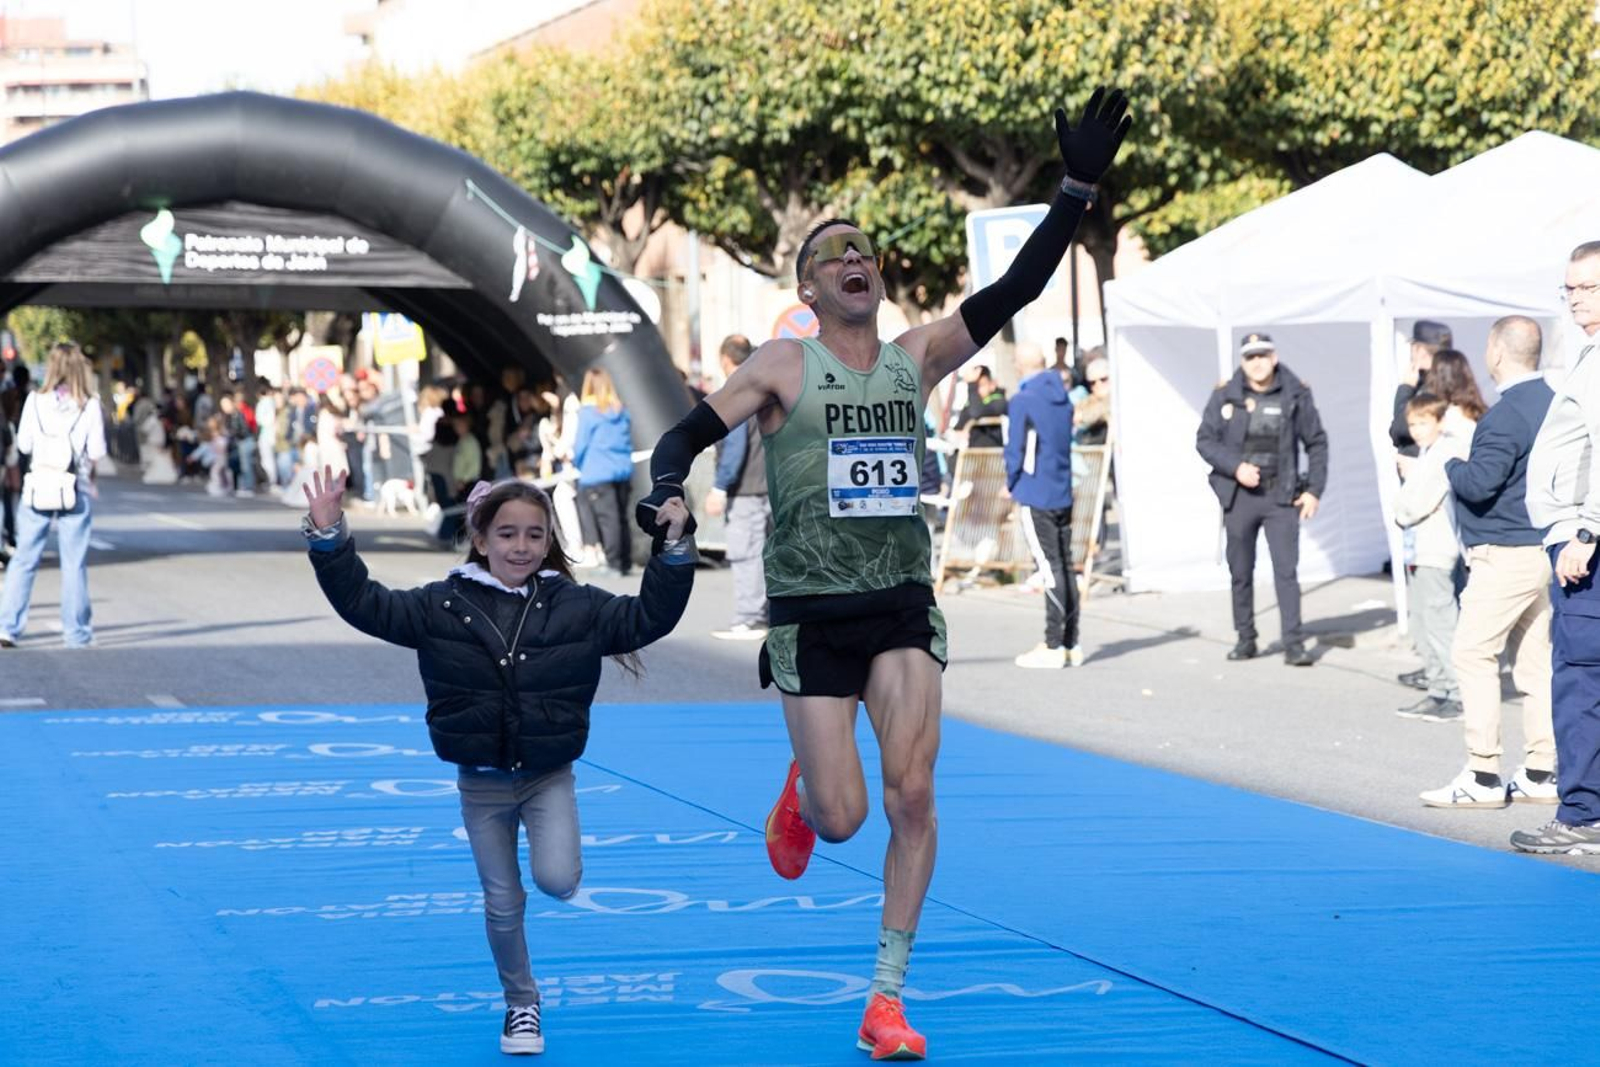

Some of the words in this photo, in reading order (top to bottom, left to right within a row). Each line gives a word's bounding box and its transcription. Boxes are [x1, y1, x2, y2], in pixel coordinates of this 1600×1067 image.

[266, 235, 344, 256] Municipal
[346, 237, 369, 254] de
[186, 252, 259, 271] Deportes
[261, 253, 284, 269] de
[825, 400, 916, 434] PEDRITO
[851, 460, 908, 487] 613
